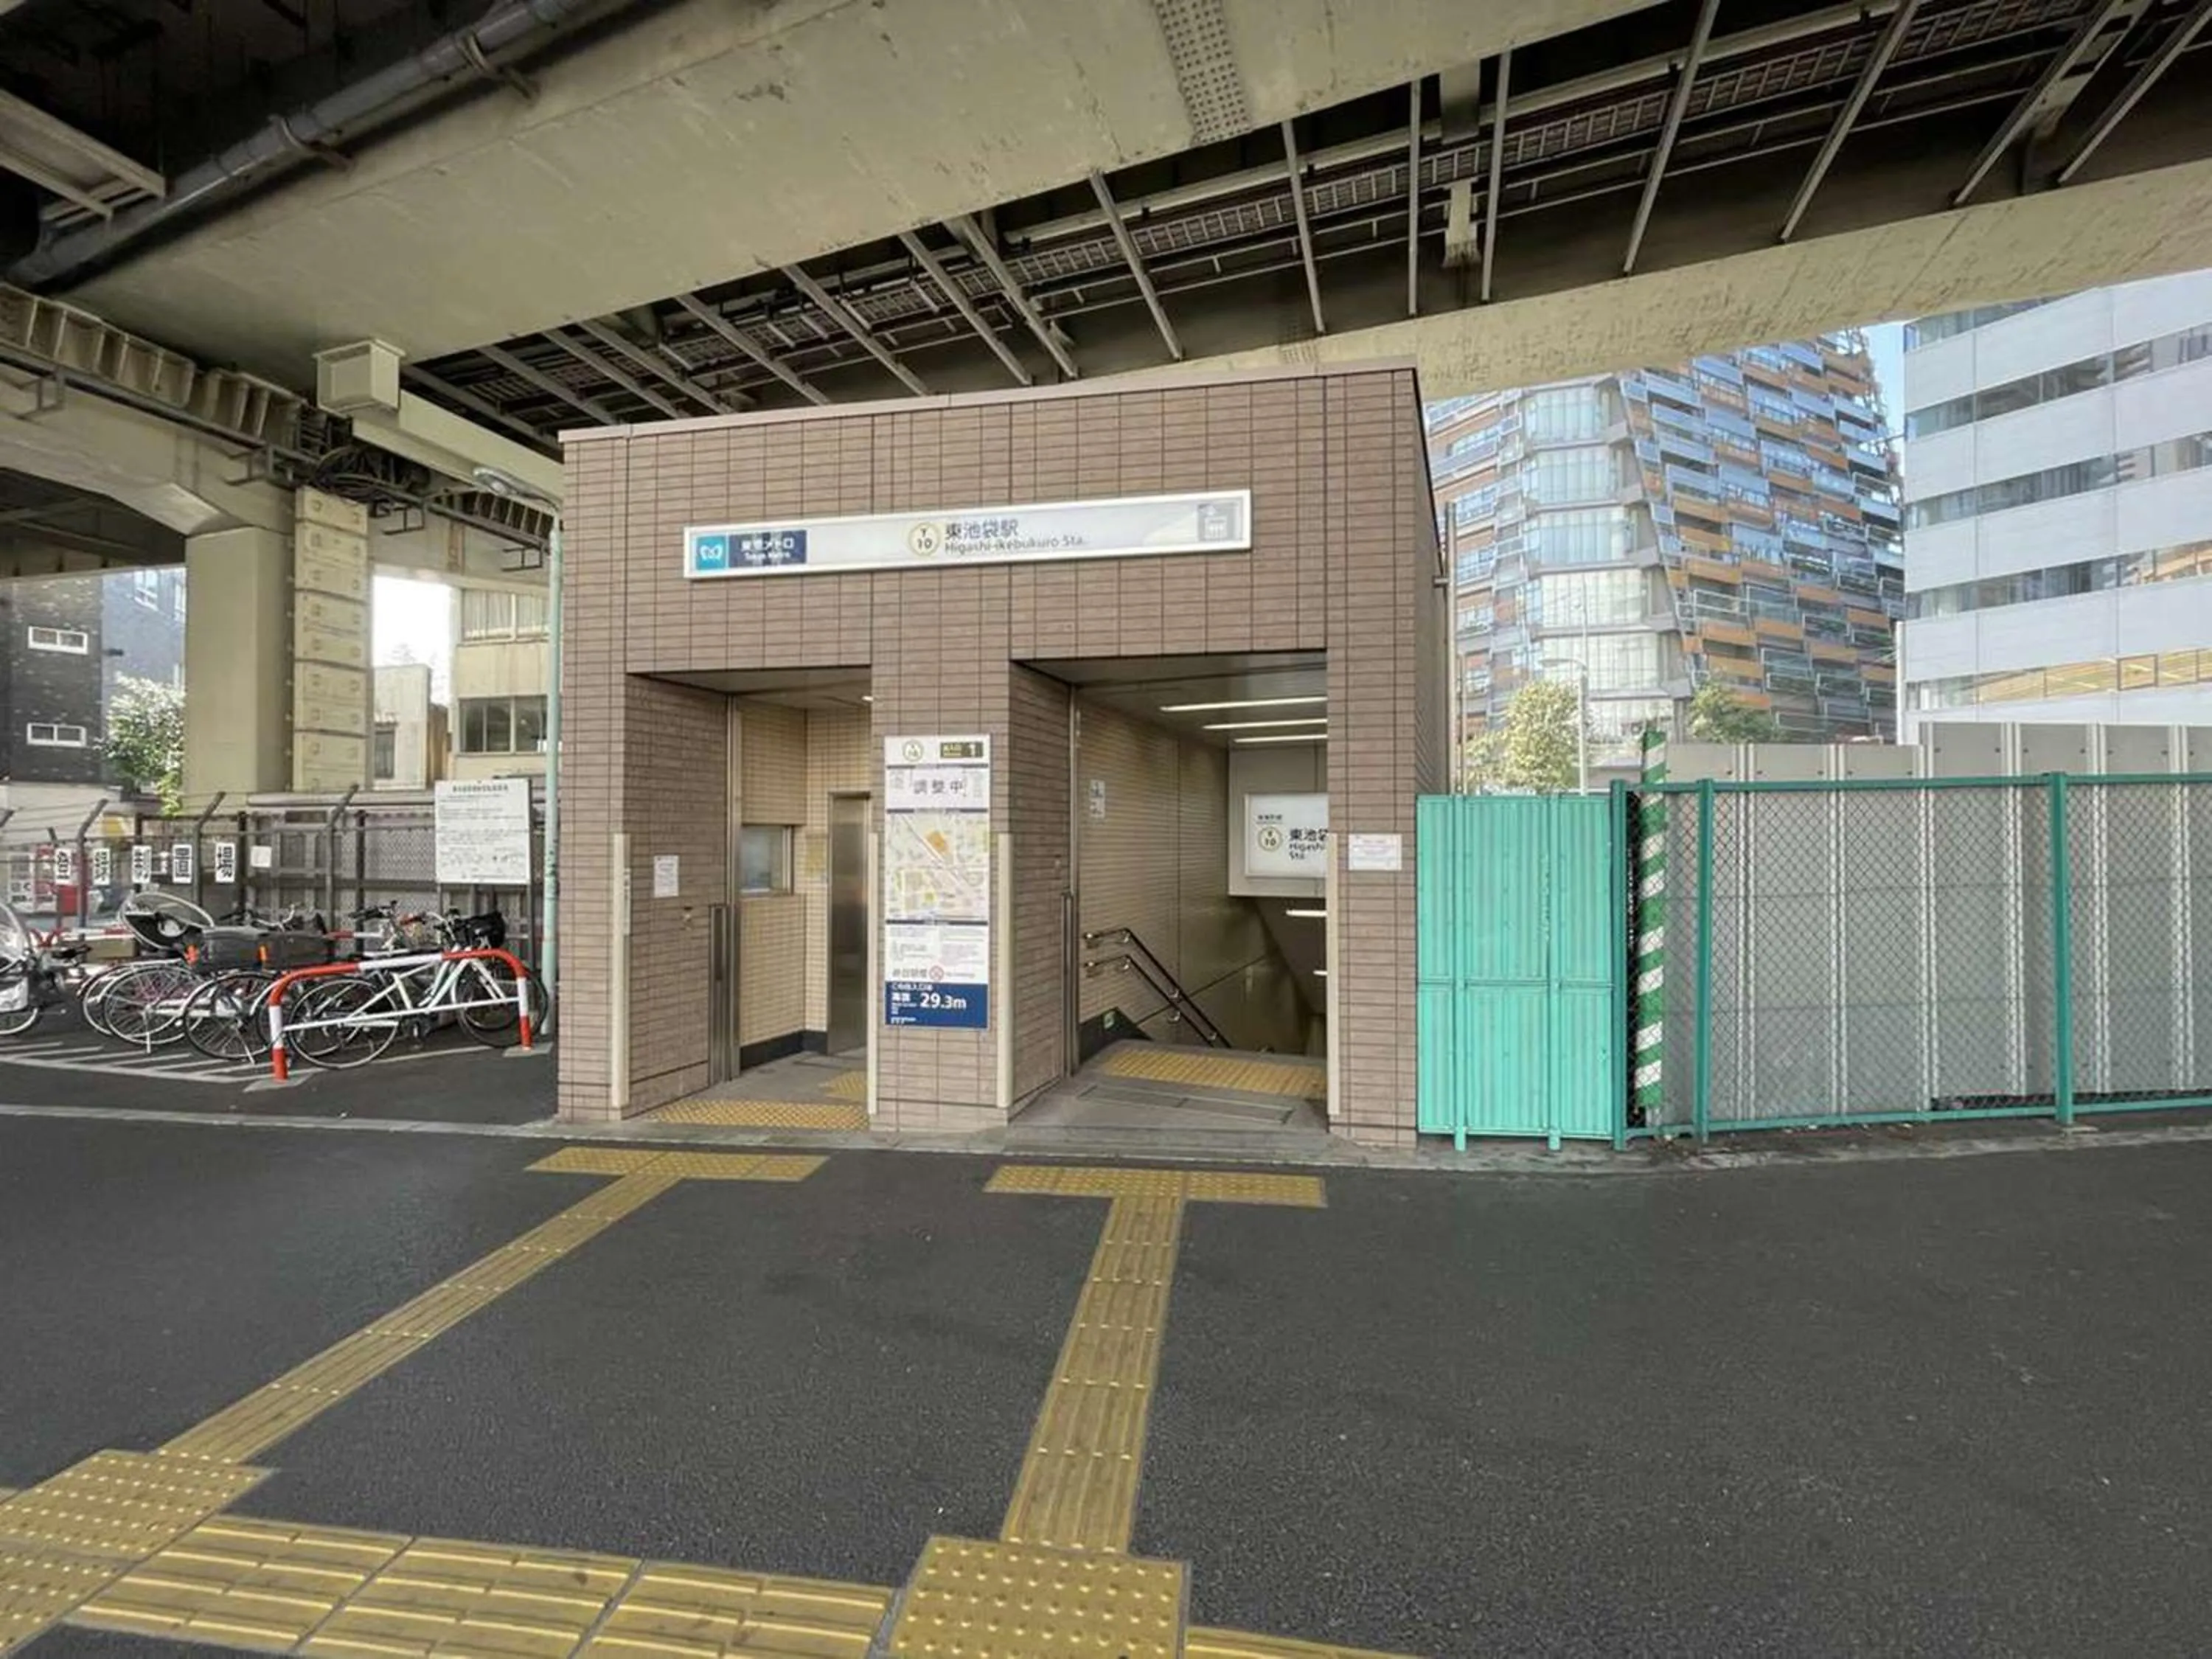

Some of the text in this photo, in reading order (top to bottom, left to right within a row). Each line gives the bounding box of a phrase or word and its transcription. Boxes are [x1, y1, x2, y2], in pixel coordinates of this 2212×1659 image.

[945, 518, 1019, 540] 東池袋駅
[919, 992, 967, 1010] 29.3m
